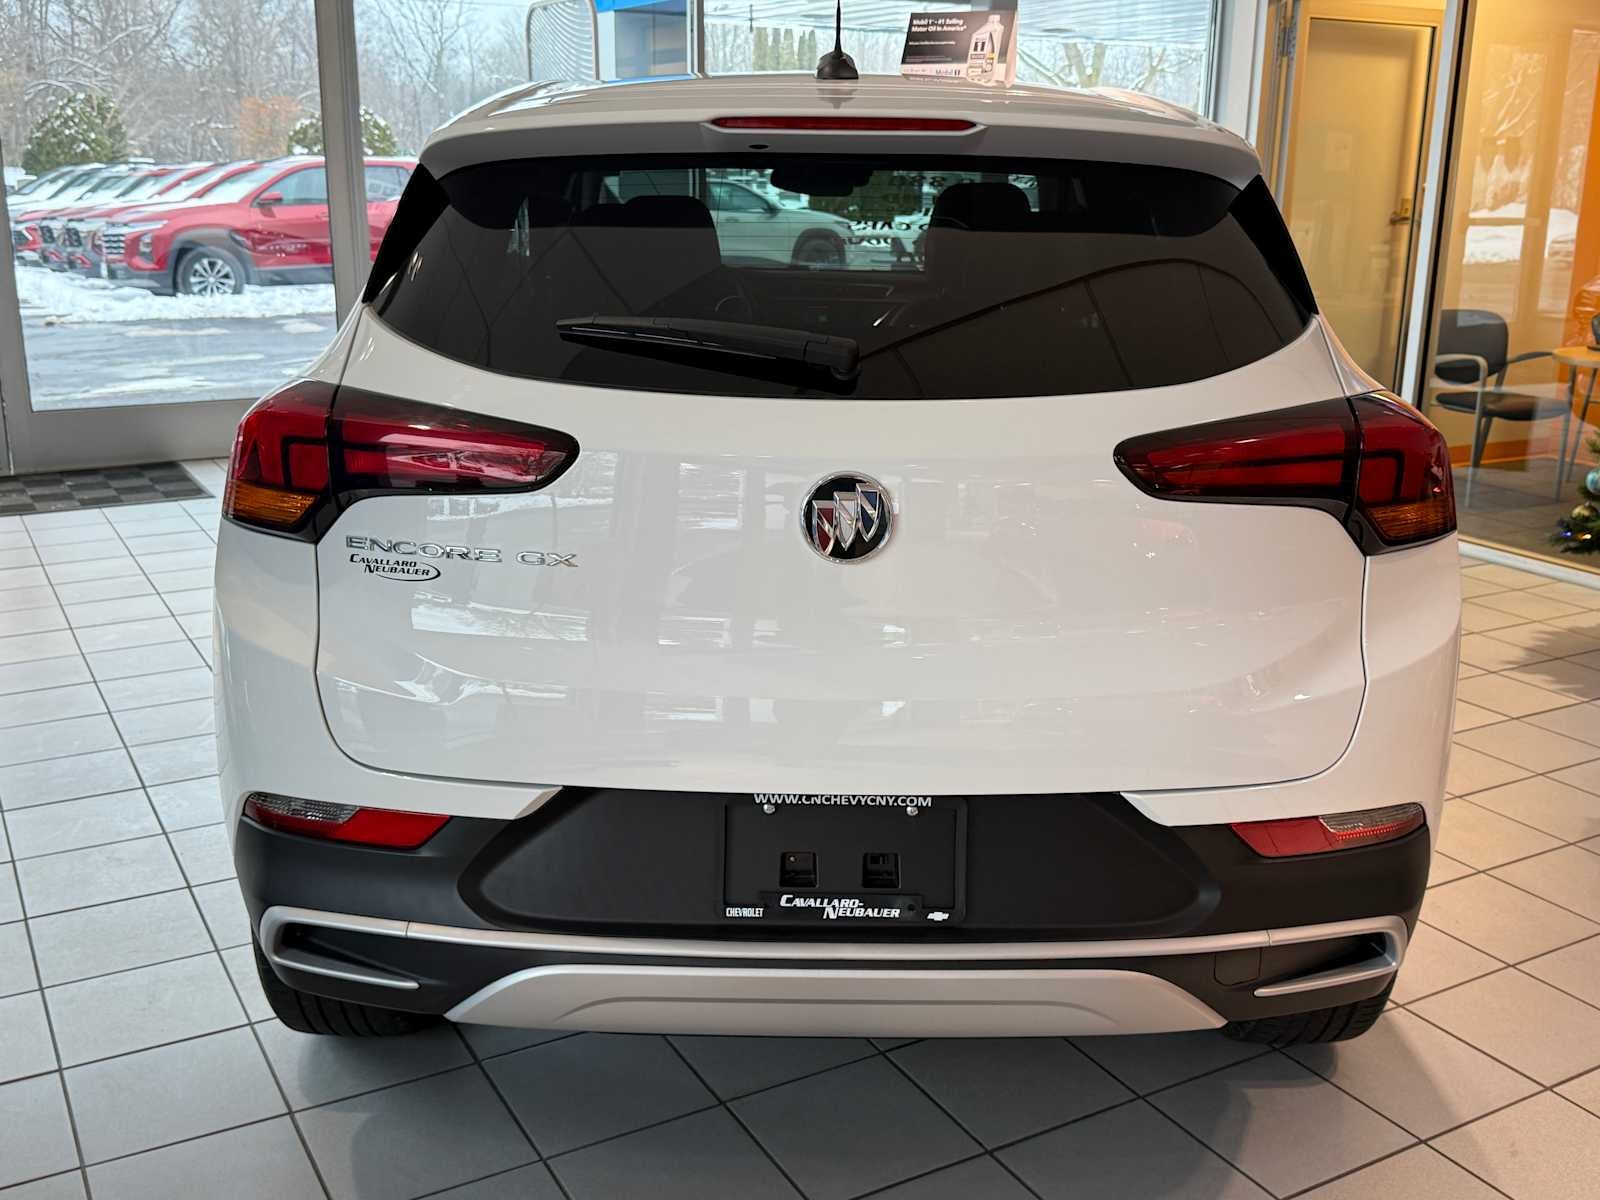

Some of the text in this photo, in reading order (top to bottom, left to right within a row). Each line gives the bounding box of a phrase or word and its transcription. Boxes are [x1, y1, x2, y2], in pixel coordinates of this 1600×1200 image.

[946, 17, 964, 26] Selling
[345, 535, 578, 567] ENCORE GX
[753, 793, 932, 807] WWW.CNCHEVYCNY.COM
[726, 907, 764, 918] CHEVROLET
[823, 906, 900, 920] NEUBAUER
